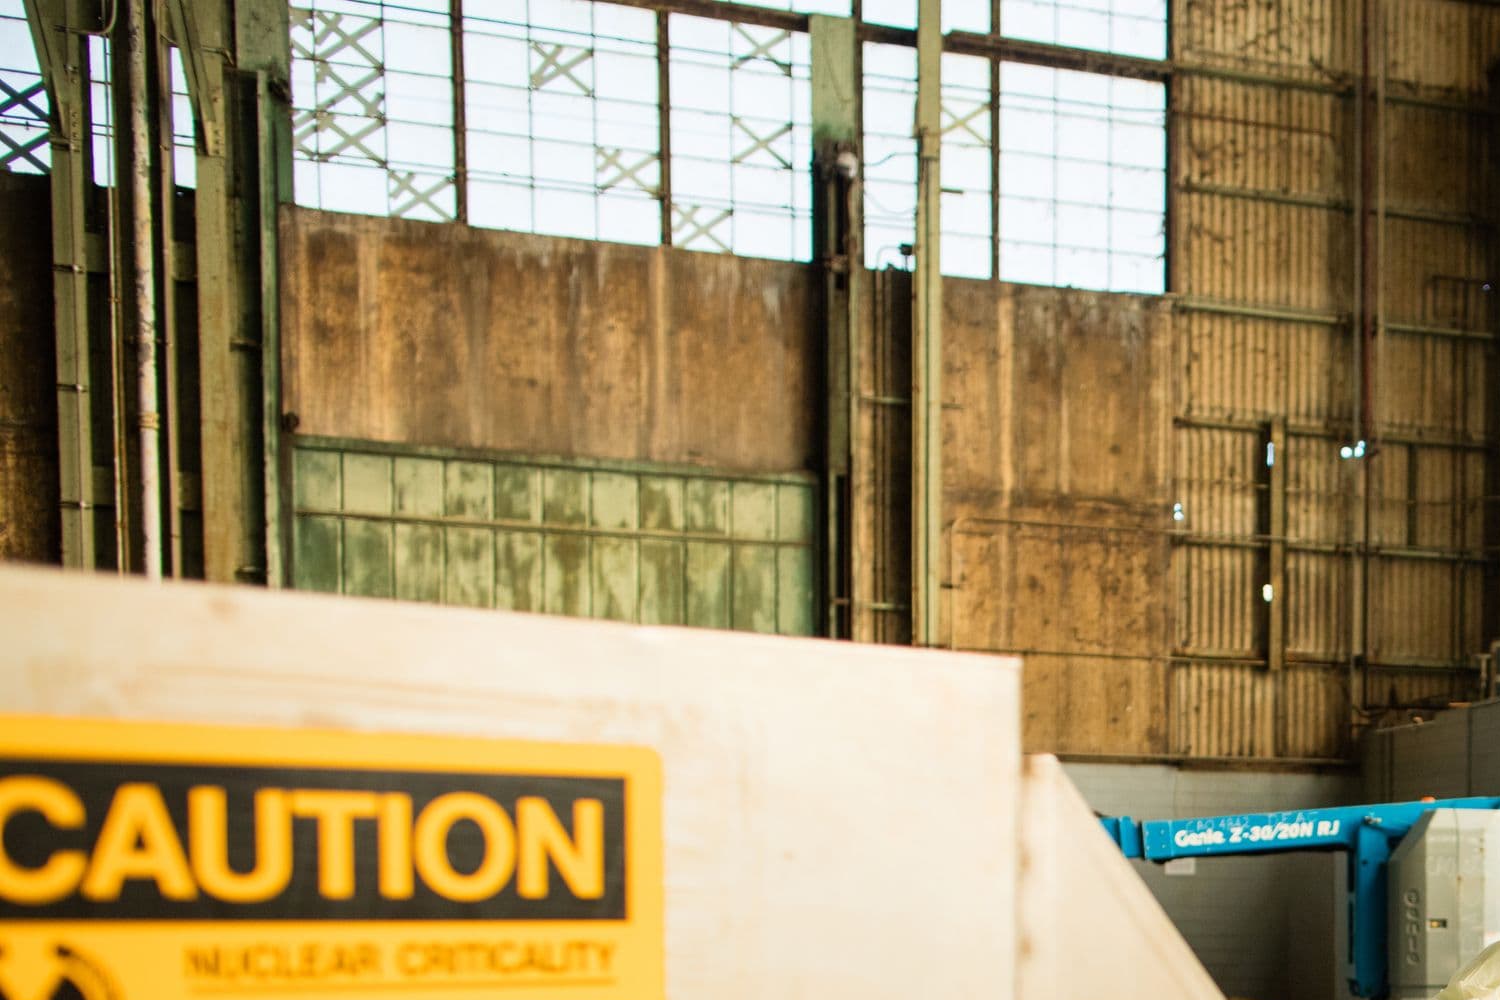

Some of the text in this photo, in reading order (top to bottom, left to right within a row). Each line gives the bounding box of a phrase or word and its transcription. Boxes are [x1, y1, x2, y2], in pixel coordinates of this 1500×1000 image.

[0, 773, 605, 905] CAUTION
[186, 938, 616, 978] NUCLEAR CRITICALITY
